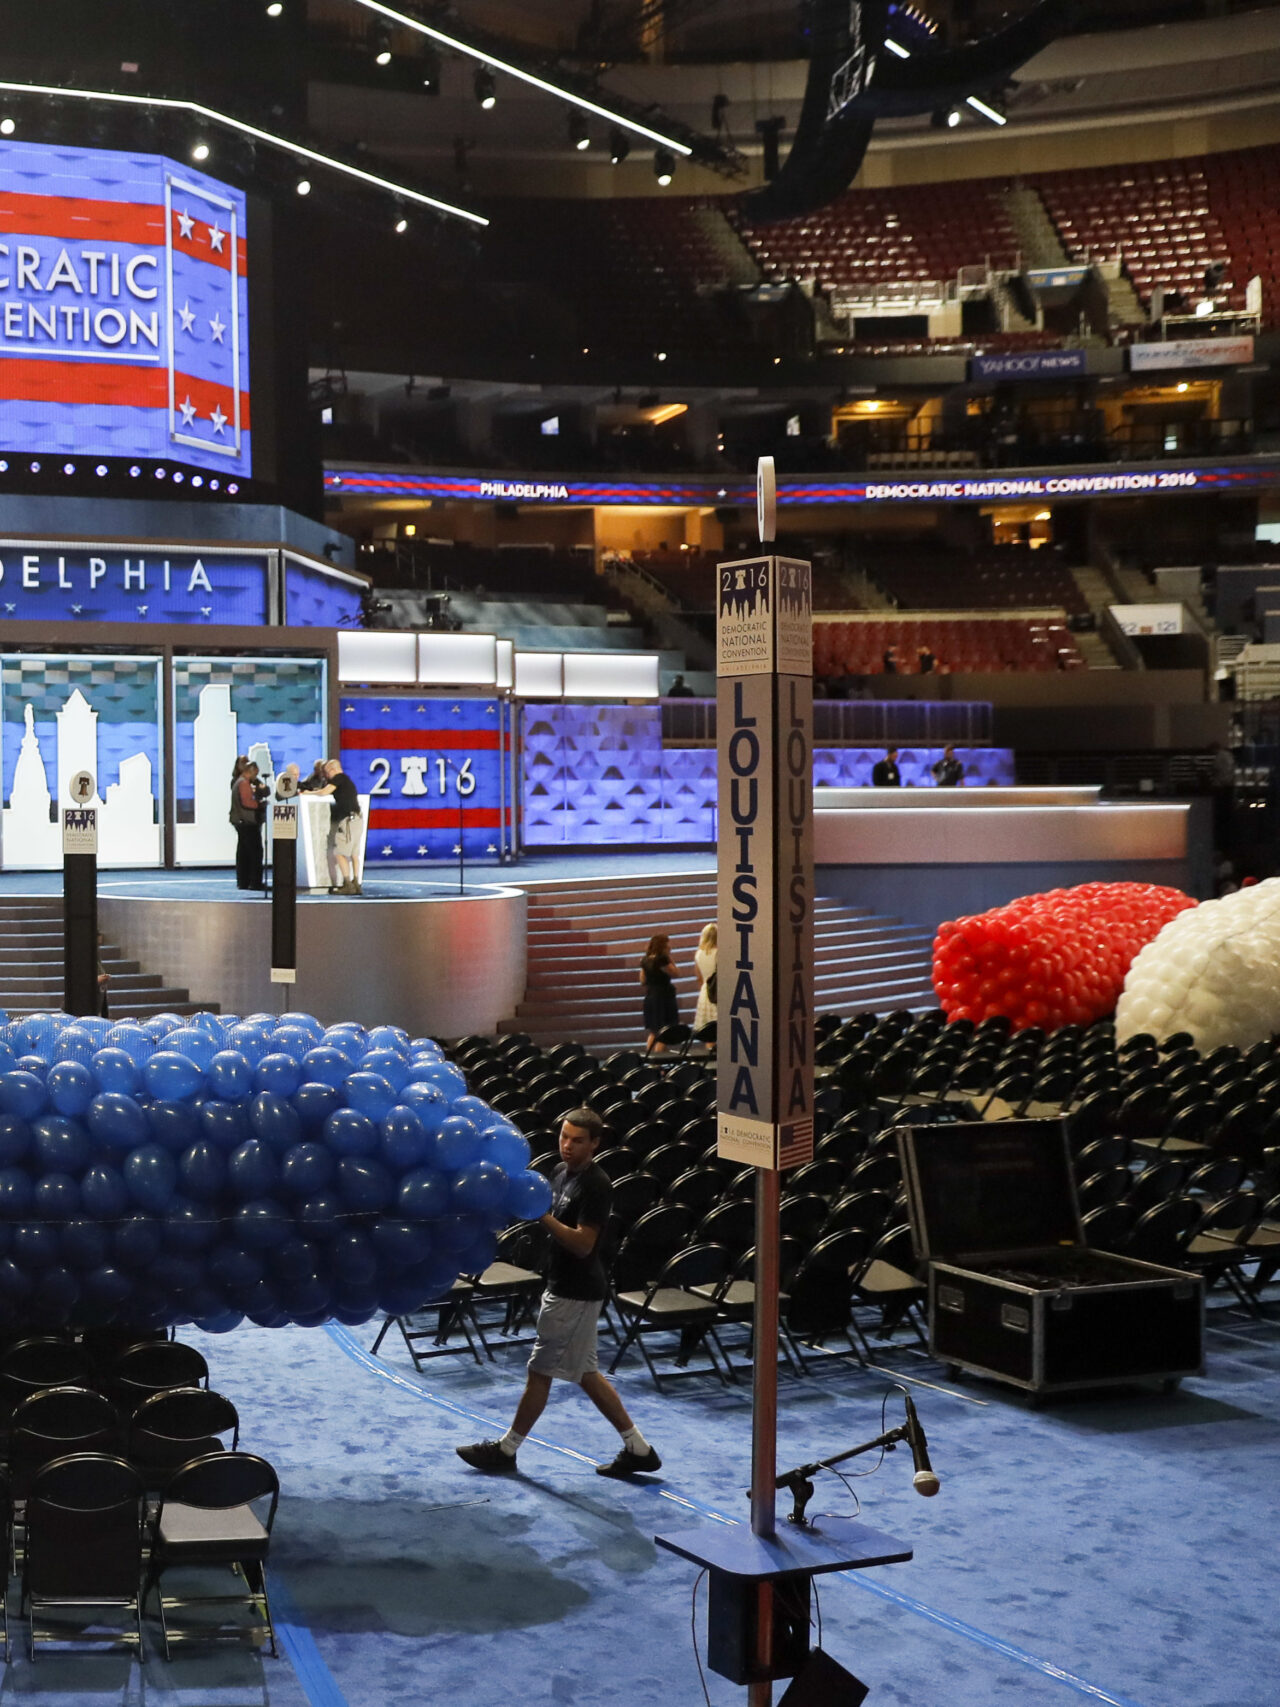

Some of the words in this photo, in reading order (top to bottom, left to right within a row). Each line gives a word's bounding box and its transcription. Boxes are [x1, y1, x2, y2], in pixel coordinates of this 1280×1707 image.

[1040, 356, 1080, 368] NEWS
[480, 482, 569, 498] PHILADELPHIA
[865, 483, 964, 499] DEMOCRATIC
[964, 480, 1044, 496] NATIONAL
[1045, 474, 1157, 493] CONVENTION
[1158, 472, 1197, 488] 2016
[722, 621, 767, 635] DEMOCRATIC
[722, 635, 767, 647] NATIONAL
[722, 646, 767, 659] CONVENTION
[728, 681, 761, 1116] LOUISIANA
[787, 681, 807, 1117] LOUISIANA
